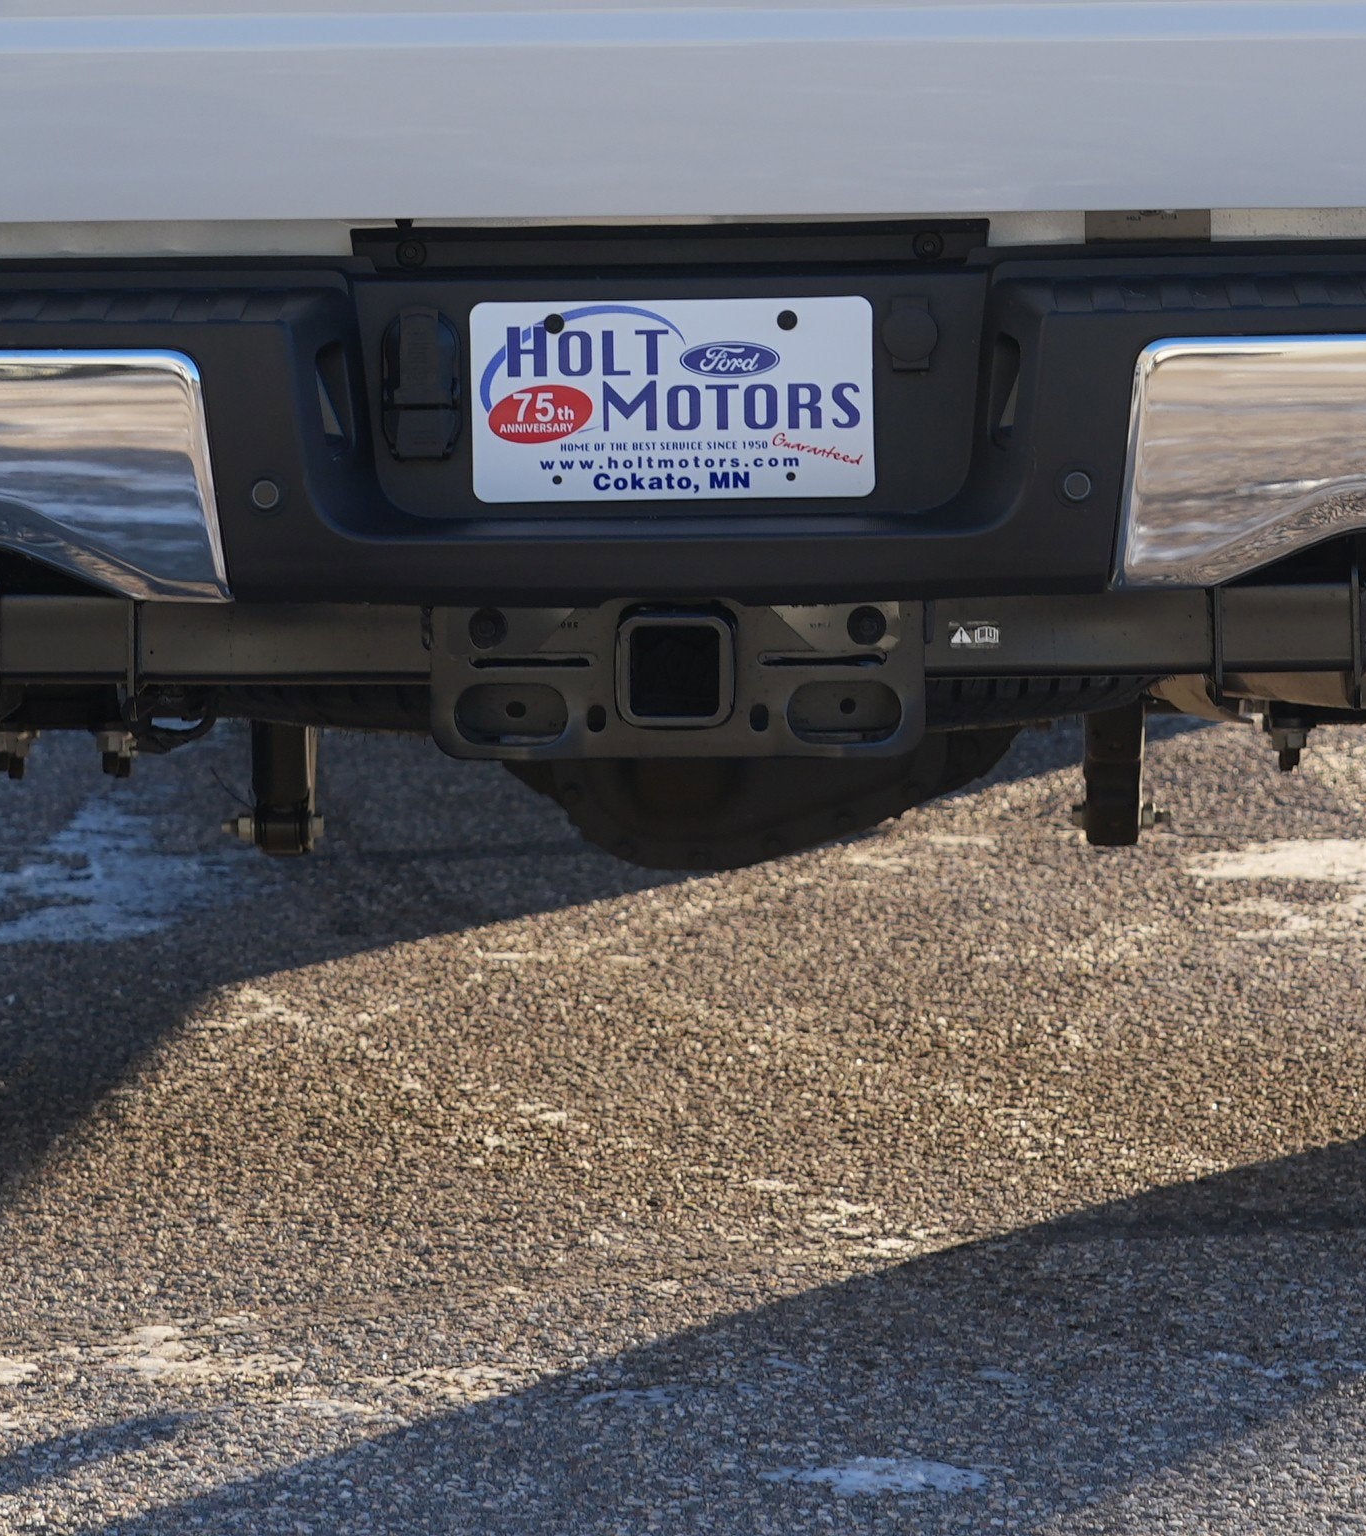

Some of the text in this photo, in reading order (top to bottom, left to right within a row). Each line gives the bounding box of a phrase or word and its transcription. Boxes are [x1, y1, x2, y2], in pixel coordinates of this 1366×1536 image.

[506, 326, 669, 378] HOLT
[699, 346, 760, 372] Ford
[512, 392, 575, 423] 75th
[602, 379, 861, 433] MOTORS
[499, 422, 574, 434] ANNIVERSARY
[560, 440, 768, 452] HOME OF THE BEST SERVICE SINCE 1950
[772, 432, 864, 466] Guaranteed
[539, 455, 800, 471] www.holtmotors.com
[593, 471, 751, 494] Cokato, MN
